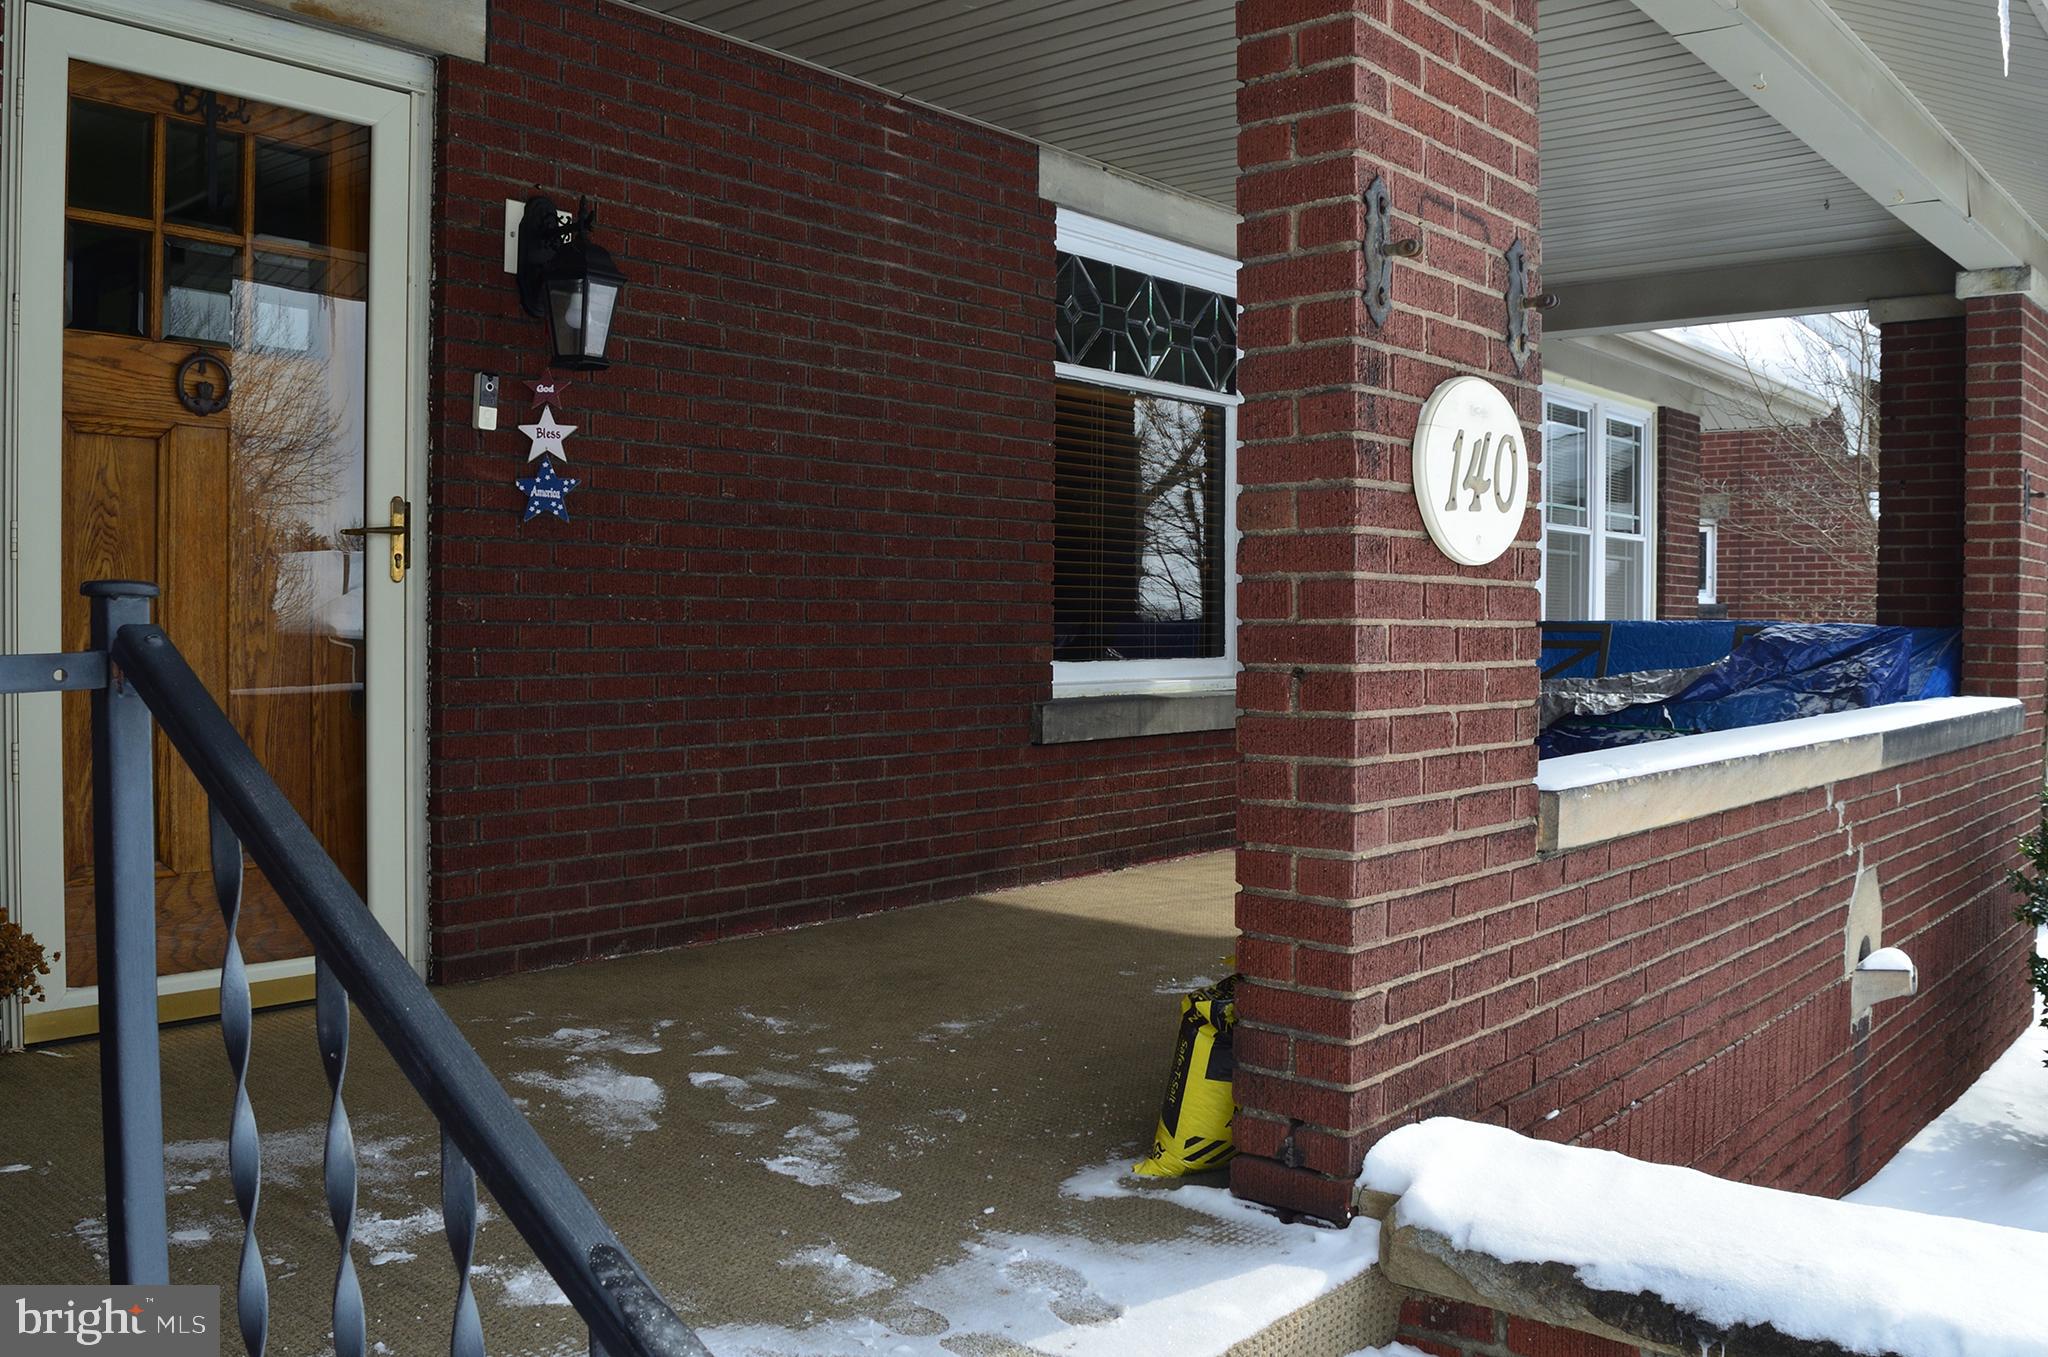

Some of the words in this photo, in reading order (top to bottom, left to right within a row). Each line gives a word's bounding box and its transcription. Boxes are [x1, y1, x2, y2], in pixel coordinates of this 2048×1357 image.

[536, 384, 555, 394] God
[536, 427, 561, 439] Bless
[1444, 429, 1518, 513] 140
[530, 485, 561, 499] America
